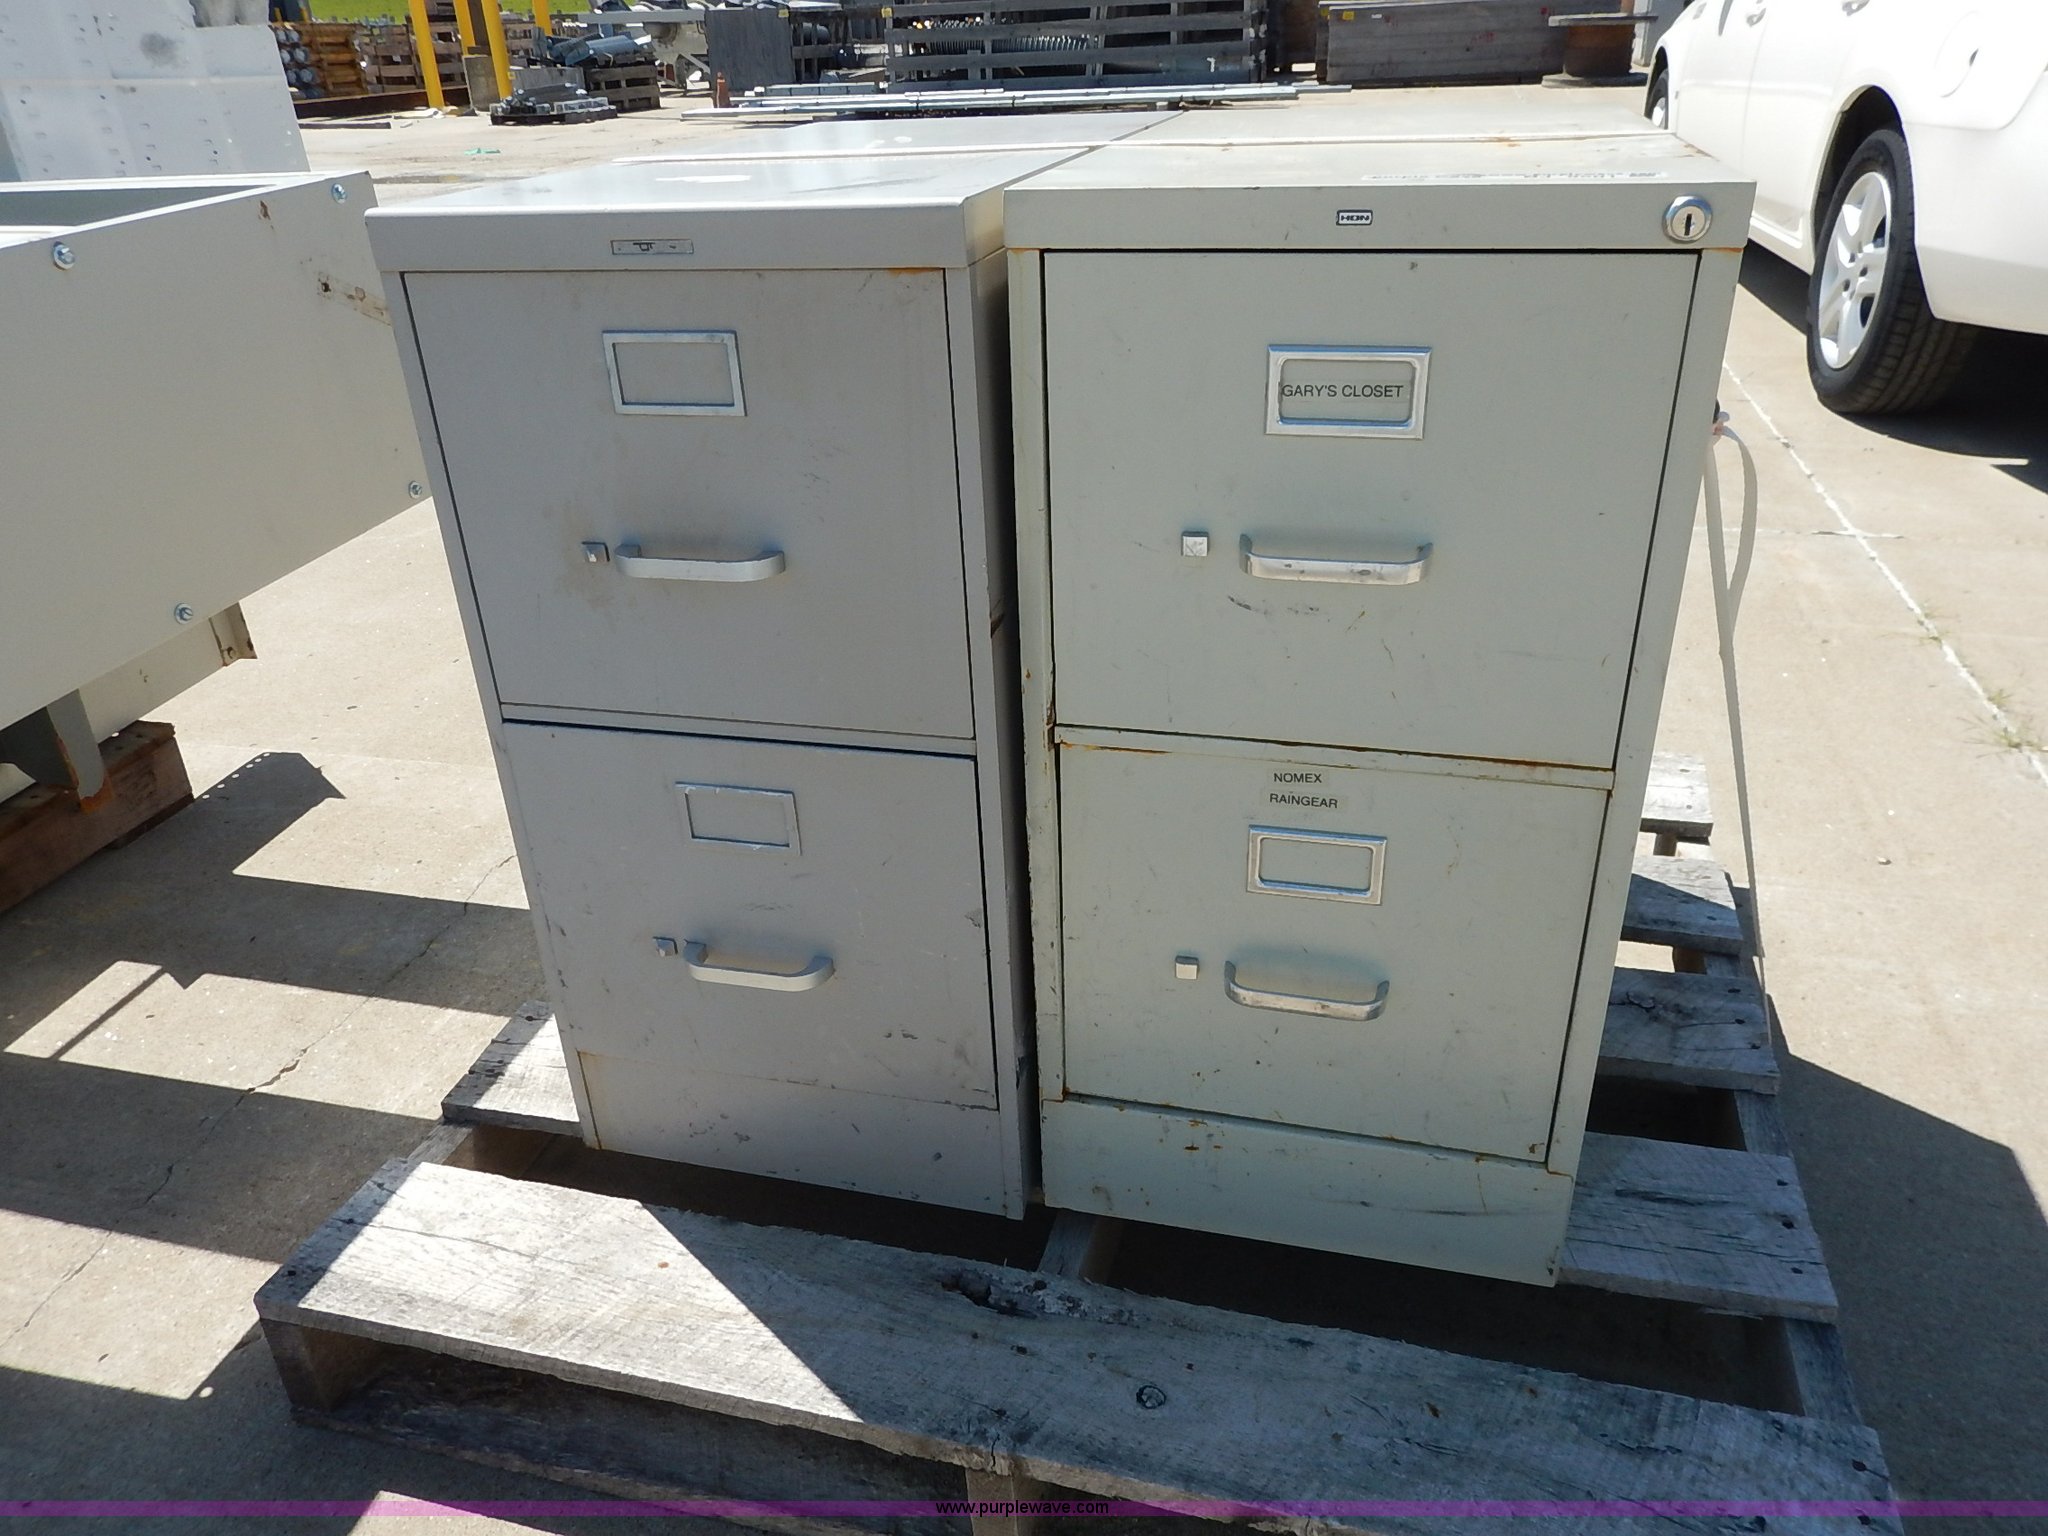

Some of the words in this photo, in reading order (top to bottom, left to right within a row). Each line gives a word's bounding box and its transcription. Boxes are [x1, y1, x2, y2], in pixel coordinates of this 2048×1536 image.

[1282, 384, 1338, 398] GARY'S
[1341, 384, 1404, 398] CLOSET
[1273, 772, 1323, 784] NOMEX
[1269, 792, 1339, 809] RAINGEAR
